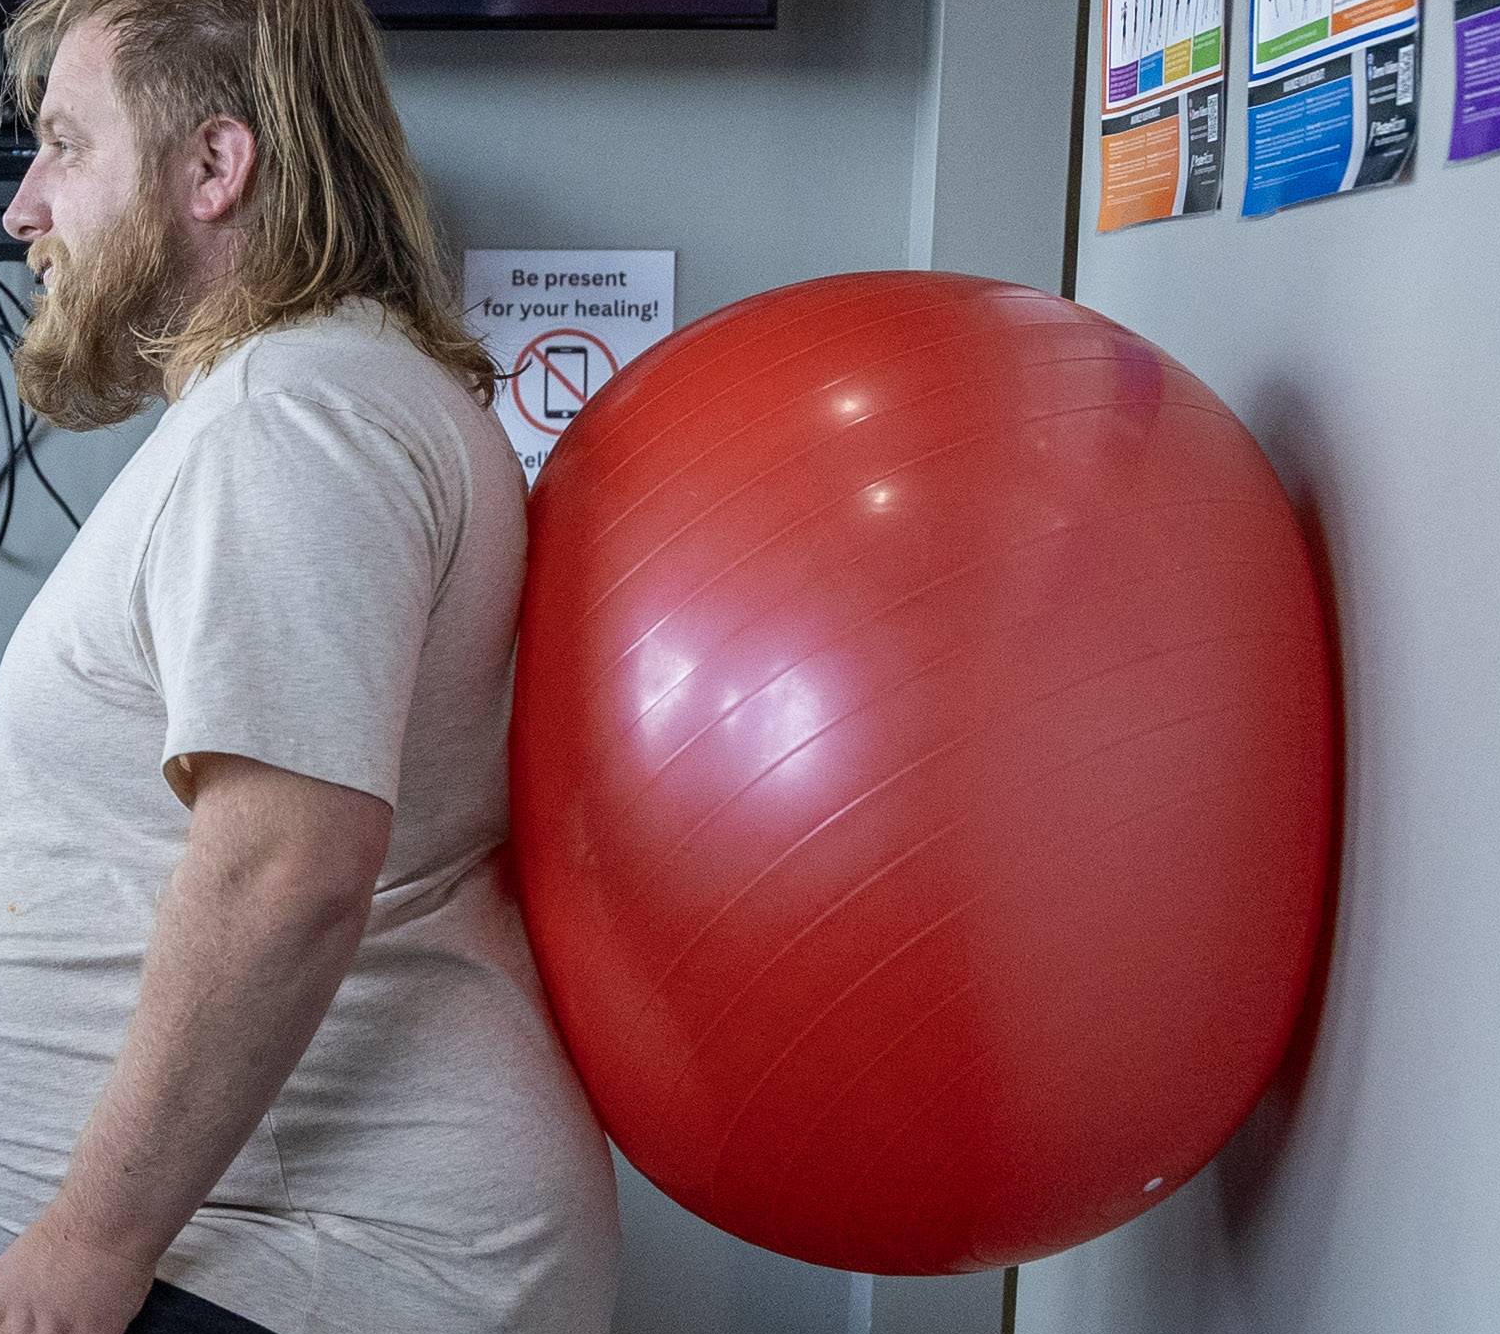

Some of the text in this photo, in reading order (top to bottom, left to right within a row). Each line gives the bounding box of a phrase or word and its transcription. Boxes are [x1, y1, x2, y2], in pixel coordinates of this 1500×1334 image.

[512, 269, 628, 290] Be present
[485, 299, 659, 322] for your healing!
[515, 450, 549, 469] el
